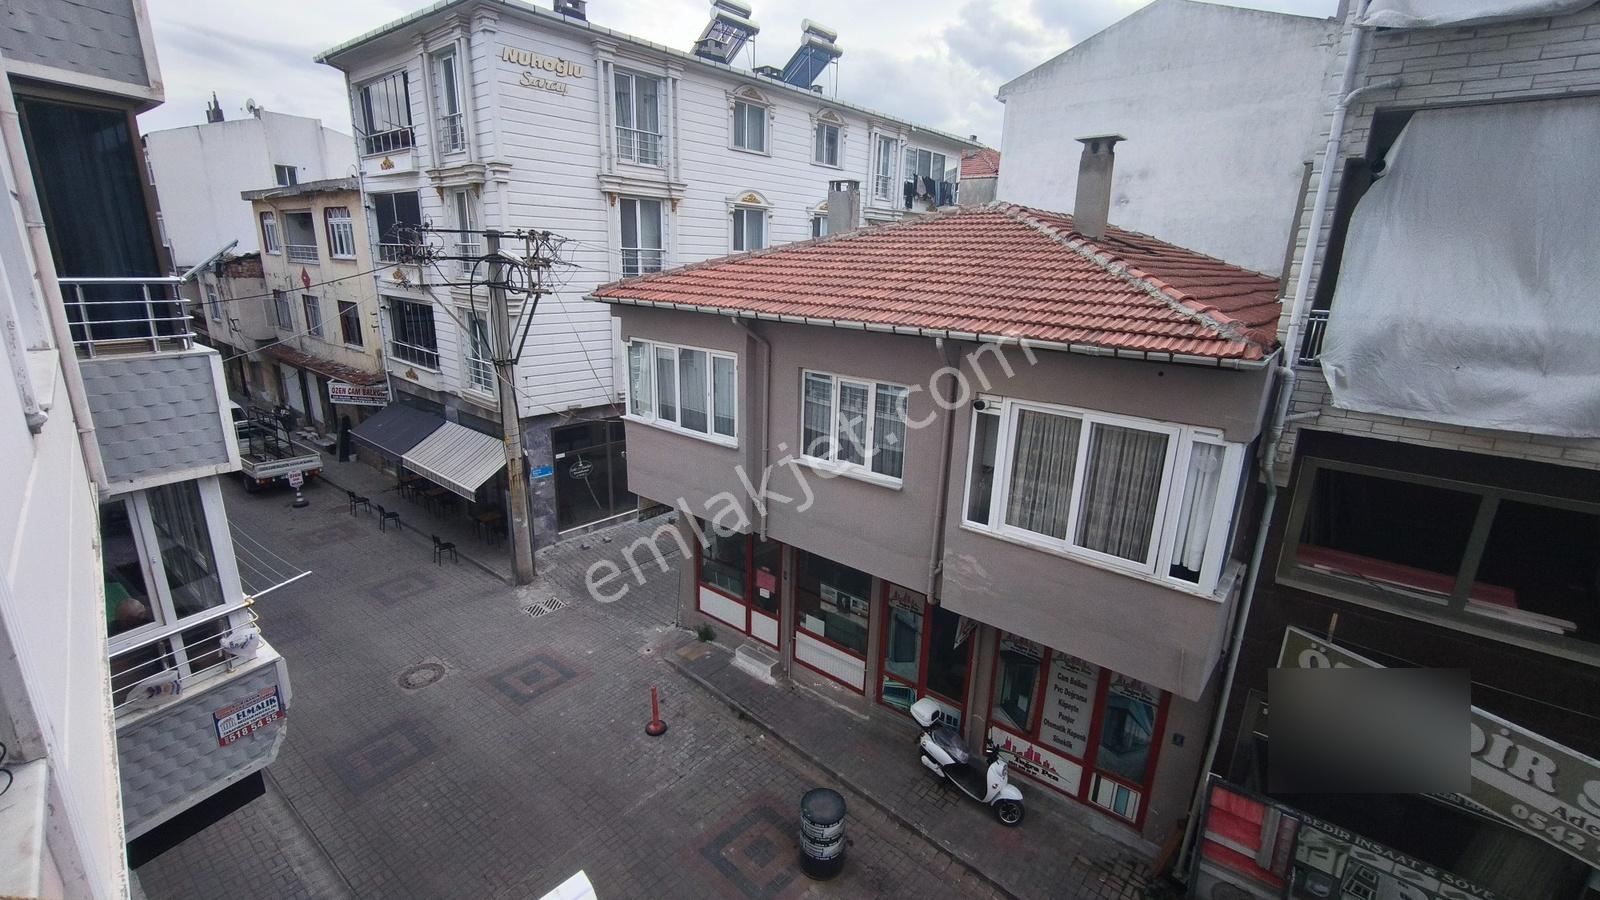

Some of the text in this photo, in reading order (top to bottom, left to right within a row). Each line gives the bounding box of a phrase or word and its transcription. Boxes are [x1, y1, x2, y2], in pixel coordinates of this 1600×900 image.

[502, 46, 584, 79] Nuhoğlu
[236, 697, 278, 721] ELMALIK
[229, 727, 250, 742] 518
[251, 720, 264, 731] 54
[1510, 803, 1587, 852] 0542
